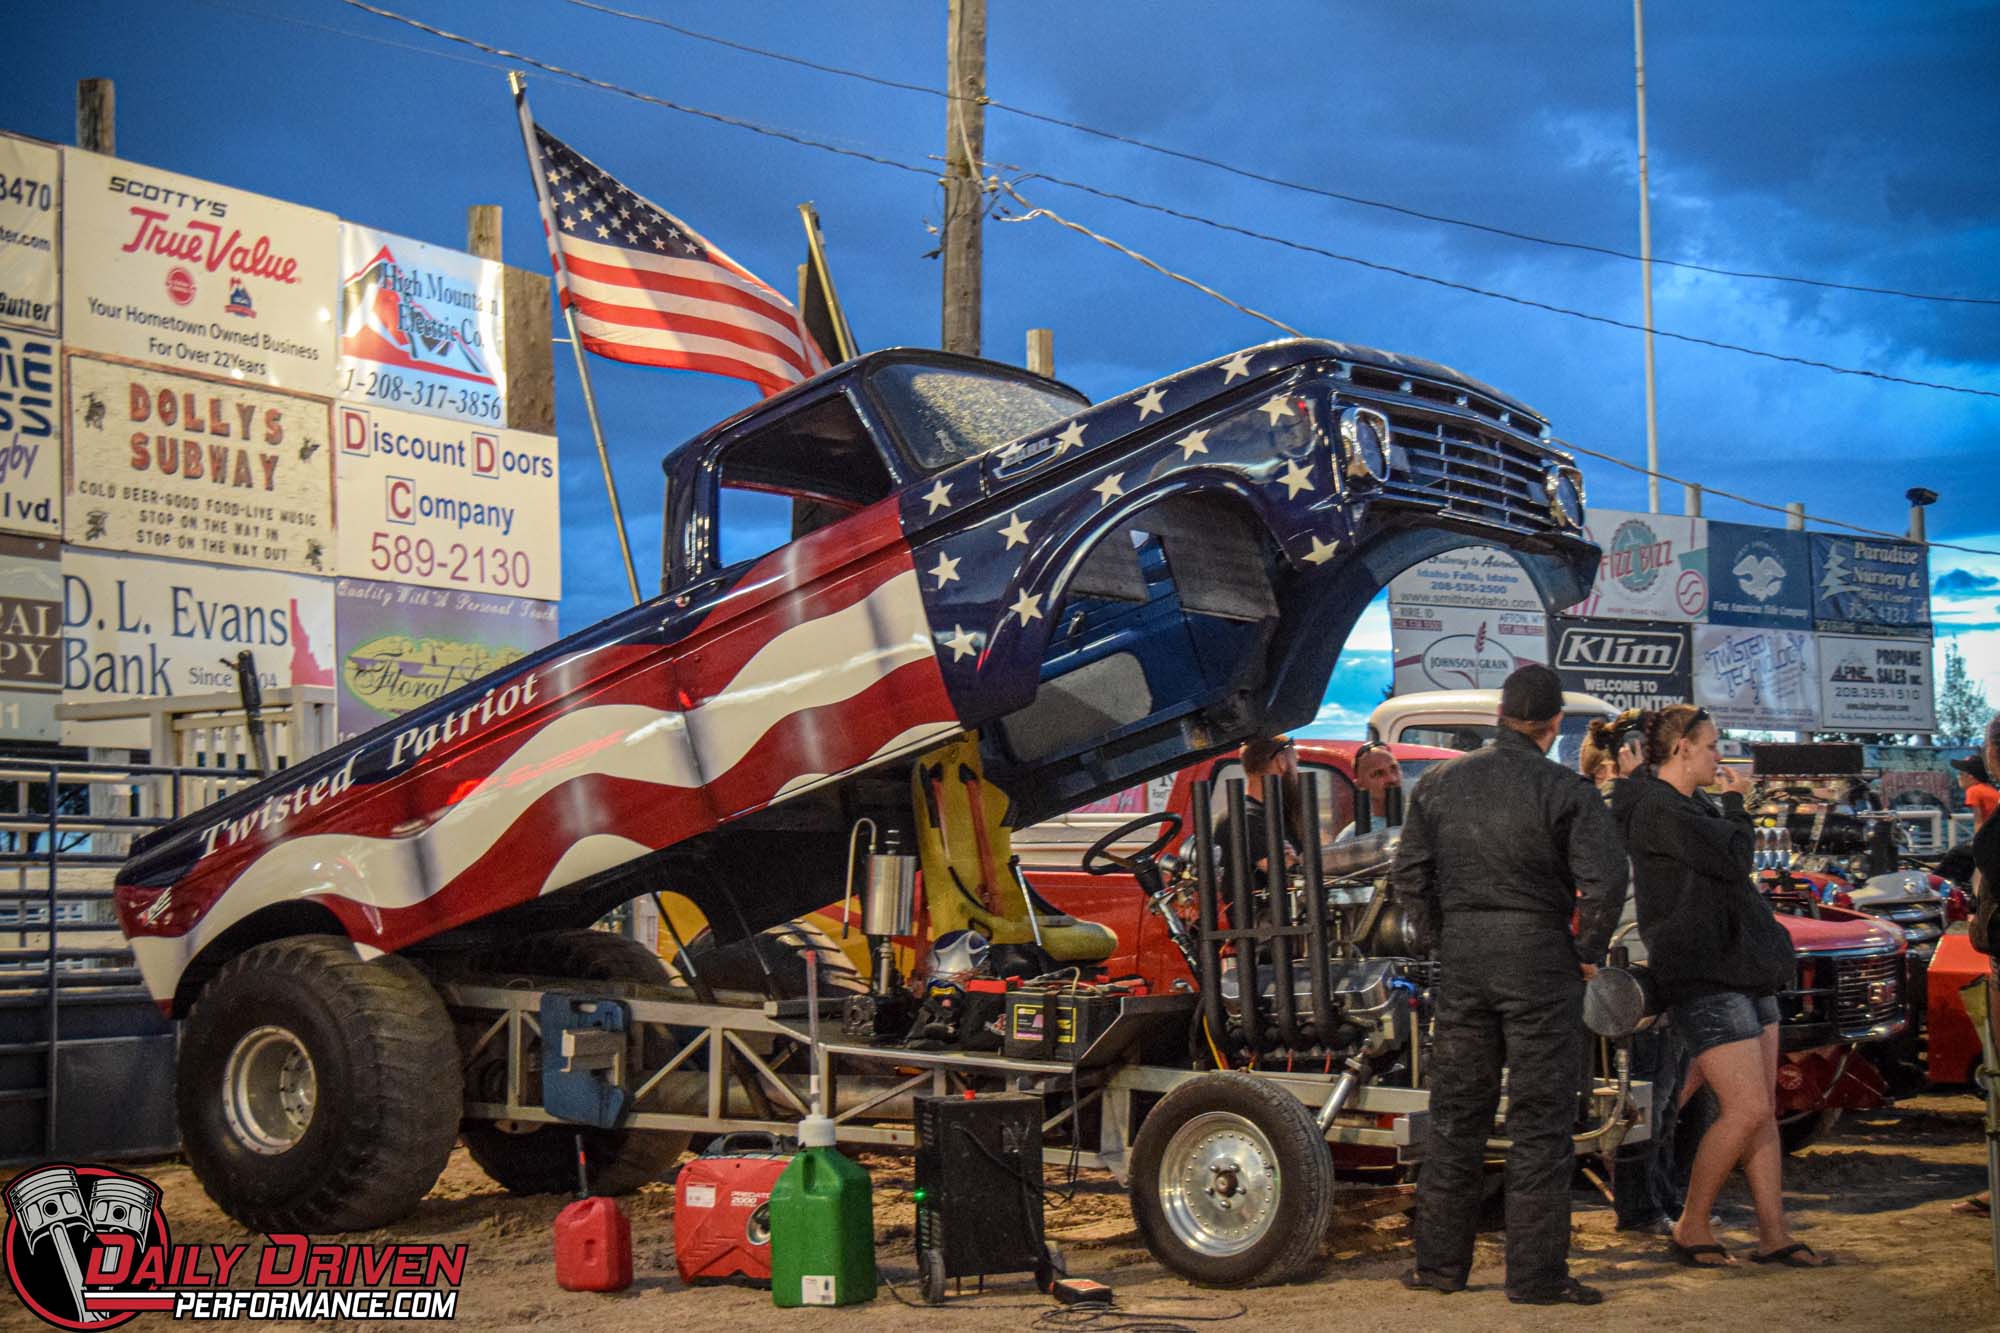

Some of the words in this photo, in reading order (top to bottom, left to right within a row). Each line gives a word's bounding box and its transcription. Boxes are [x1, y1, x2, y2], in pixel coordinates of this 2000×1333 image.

[108, 176, 227, 217] SCOTTY'S
[122, 206, 204, 262] True
[187, 220, 300, 284] Value
[382, 262, 422, 300] High
[88, 296, 121, 320] Your
[126, 305, 207, 336] Hometown
[209, 323, 259, 348] Owned
[263, 334, 319, 360] Business
[148, 337, 172, 354] For
[176, 343, 209, 364] Over
[344, 368, 502, 420] 1-208-317-3856
[130, 432, 279, 491] SUBWAY
[344, 411, 465, 468] Discount
[475, 437, 553, 478] Doors
[78, 480, 115, 499] COLD
[280, 511, 317, 527] MUSIC
[390, 481, 514, 536] Company
[136, 529, 170, 545] STOP
[178, 535, 195, 549] ON
[202, 538, 225, 554] THE
[233, 543, 257, 557] WAY
[264, 547, 288, 561] OUT
[139, 510, 174, 526] STOP
[181, 514, 198, 529] ON
[204, 518, 228, 534] THE
[235, 523, 260, 538] WAY
[266, 527, 279, 541] IN
[371, 532, 530, 588] 589-2130
[1600, 551, 1632, 581] FIZZ
[1640, 540, 1673, 573] BIZZ
[1855, 542, 1919, 564] Paradise
[336, 580, 392, 607] Quality
[1416, 568, 1450, 579] Idaho
[1487, 572, 1519, 583] Idaho
[170, 585, 288, 647] Evans
[63, 637, 173, 697] Bank
[188, 665, 233, 687] Since
[1430, 656, 1475, 669] JOHNSON
[1479, 658, 1508, 669] GRAIN
[1876, 648, 1922, 667] PROPANE
[1876, 667, 1907, 685] SALES
[1583, 678, 1641, 692] WELCOME
[1642, 680, 1658, 693] TO
[200, 748, 366, 859] Twisted
[387, 672, 538, 771] Patriot
